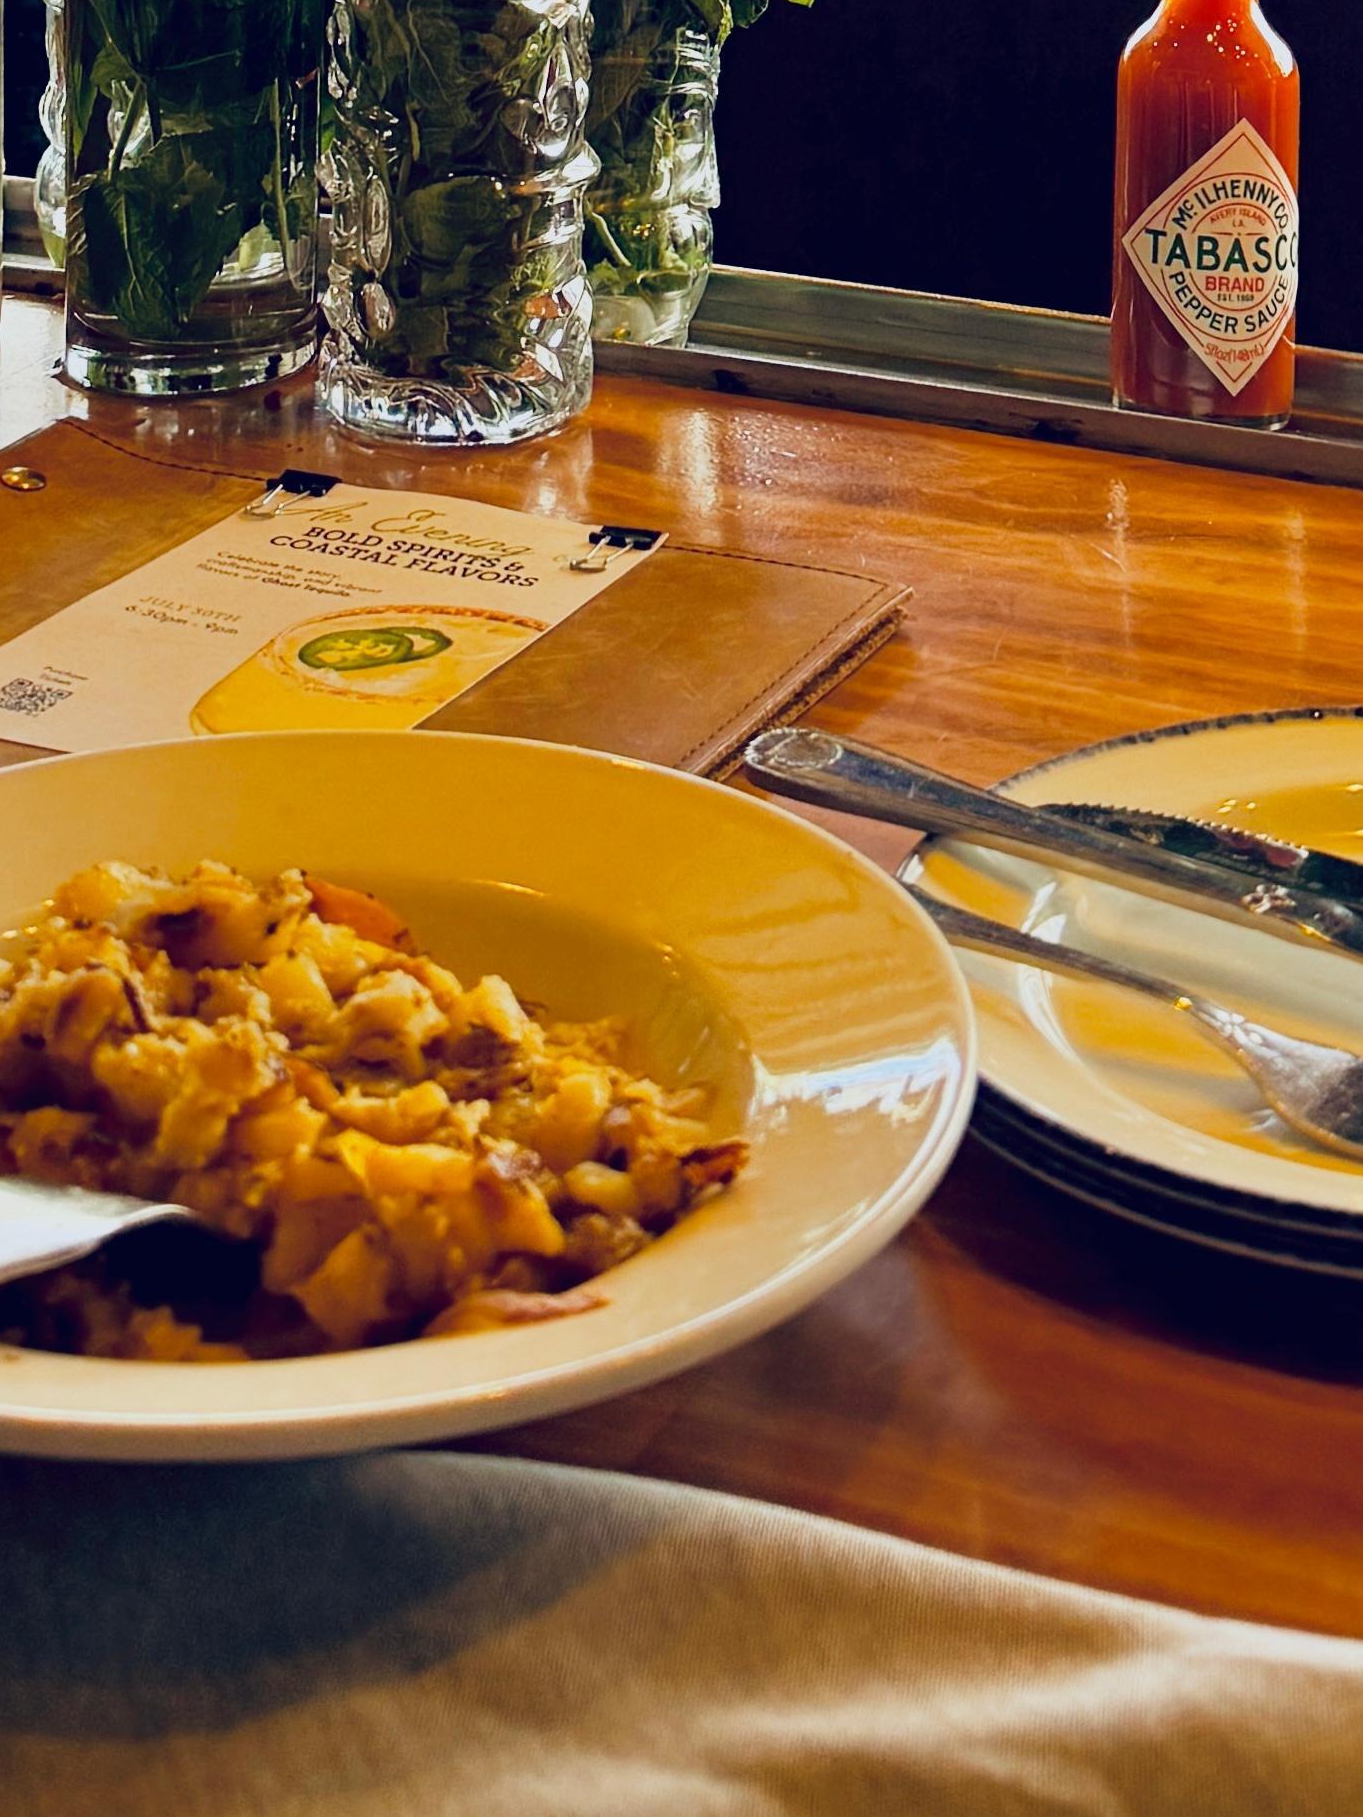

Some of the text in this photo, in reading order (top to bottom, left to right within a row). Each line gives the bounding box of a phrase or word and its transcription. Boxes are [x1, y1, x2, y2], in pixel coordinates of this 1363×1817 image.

[1169, 271, 1288, 334] PEPPER SAUCE
[1205, 276, 1265, 292] BRAND
[282, 501, 535, 557] An Evening
[303, 526, 525, 572] BOLD SPIRITS &
[270, 534, 400, 569] COASTAL
[405, 558, 540, 588] FLAVORS
[139, 596, 242, 622] JULY 30TH
[205, 623, 239, 634] 9pm
